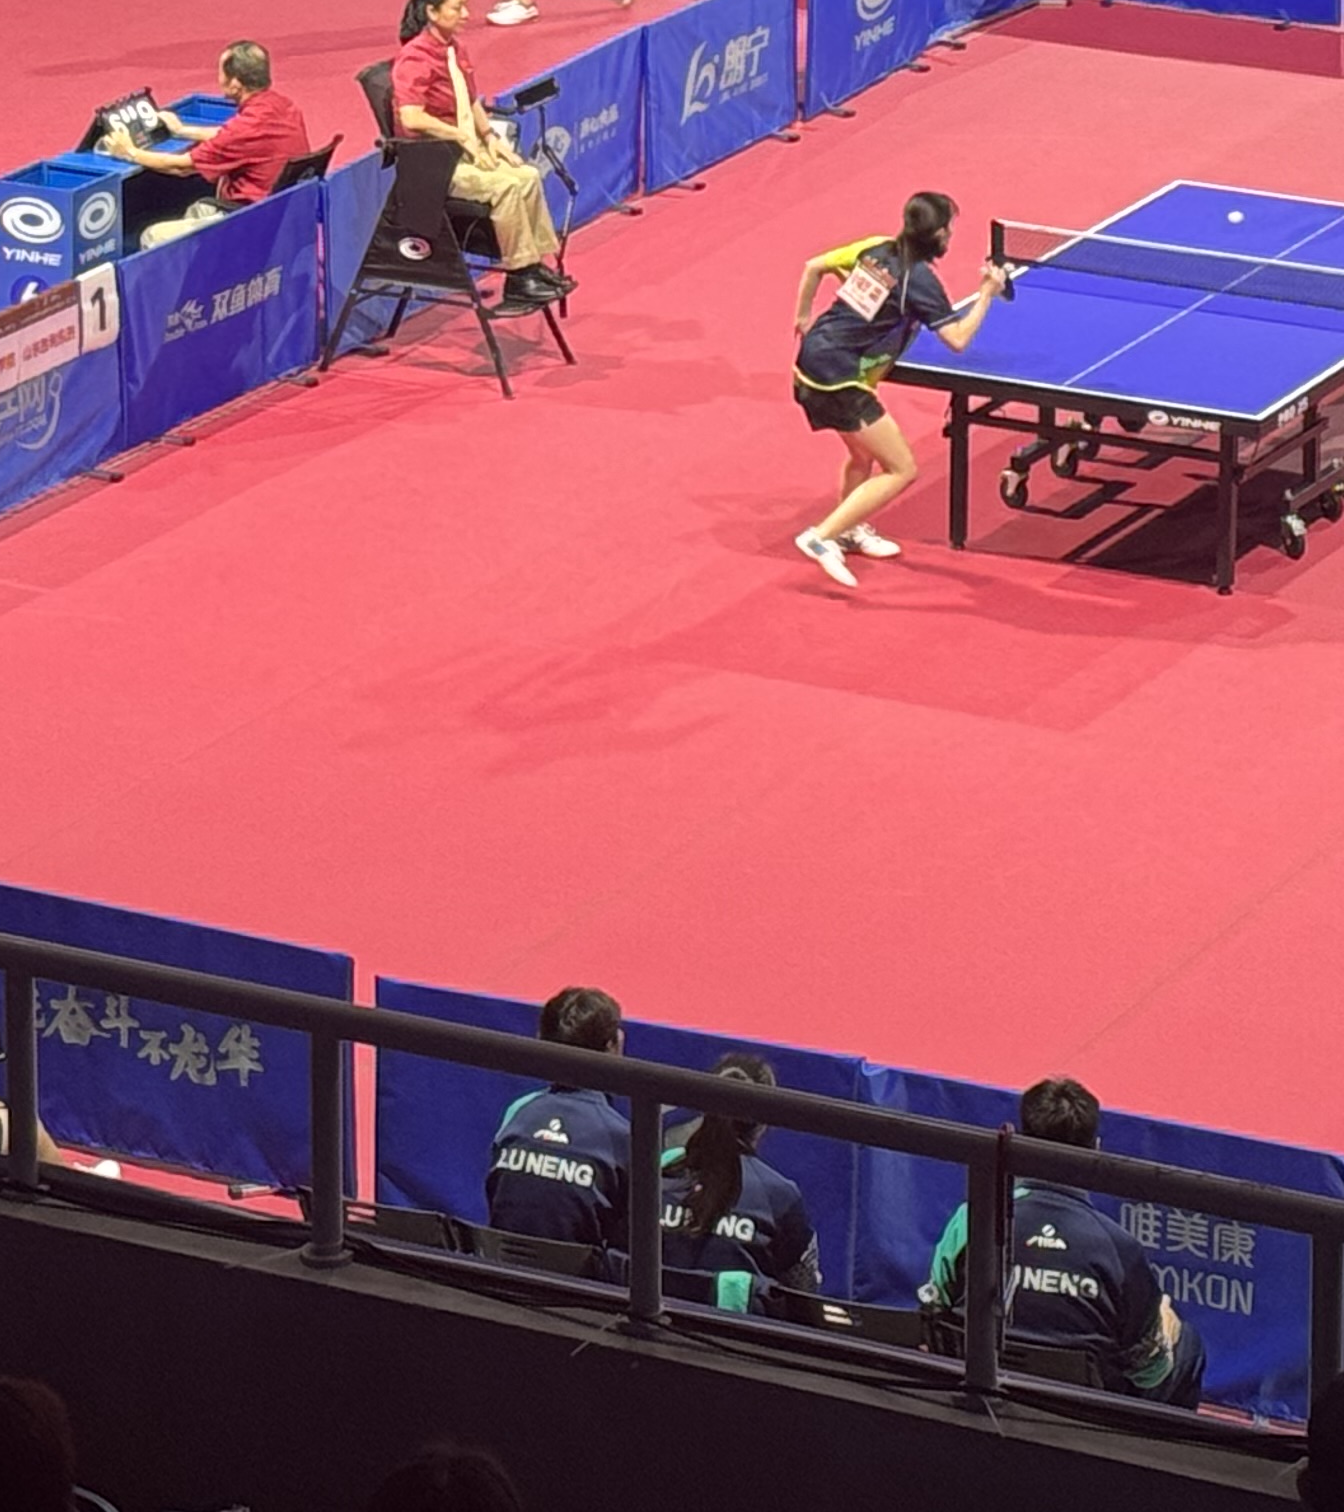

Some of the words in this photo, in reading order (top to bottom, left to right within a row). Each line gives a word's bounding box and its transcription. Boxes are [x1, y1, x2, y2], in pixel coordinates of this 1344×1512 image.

[854, 14, 896, 54] YINHE
[1, 244, 63, 268] YINHE
[90, 286, 108, 333] 1
[210, 266, 283, 324] 双鱼体育
[495, 1146, 595, 1189] LUNENG
[1119, 1200, 1256, 1268] 唯美康
